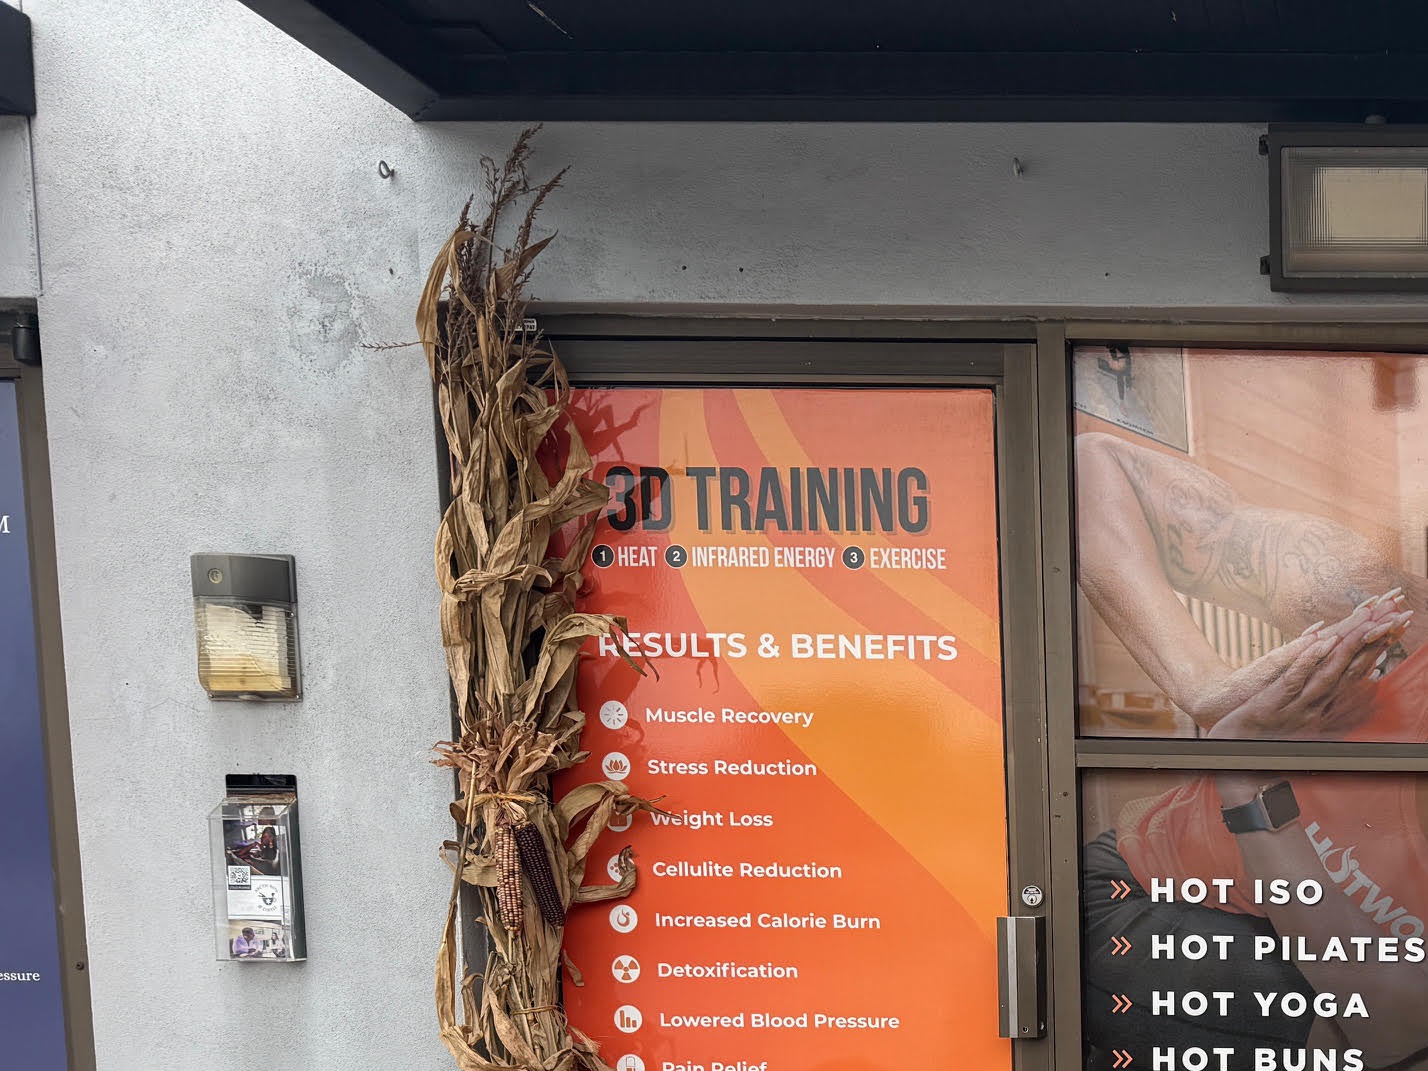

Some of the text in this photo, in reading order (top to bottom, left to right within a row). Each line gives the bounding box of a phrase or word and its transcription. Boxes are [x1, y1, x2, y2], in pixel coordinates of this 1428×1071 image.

[606, 466, 928, 532] 3D TRAINING
[618, 547, 657, 568] HEAT
[692, 546, 770, 568] INFRARED
[774, 546, 835, 568] ENERGY
[871, 548, 946, 569] EXERCISE
[600, 633, 957, 660] RESULTS & BENEFITS
[647, 708, 813, 727] Muscle Recovery
[648, 760, 816, 775] Stress Reduction
[651, 810, 773, 829] Weight Loss
[653, 861, 841, 878] Cellulite Reduction
[1151, 878, 1322, 904] HOT ISO
[656, 913, 880, 928] Increased Calorie Burn
[1152, 935, 1424, 962] HOT PILATES
[658, 962, 797, 978] Detoxification
[1153, 991, 1369, 1017] HOT YOGA
[661, 1013, 899, 1028] Lowered Blood Pressure
[1153, 1047, 1234, 1071] HOT
